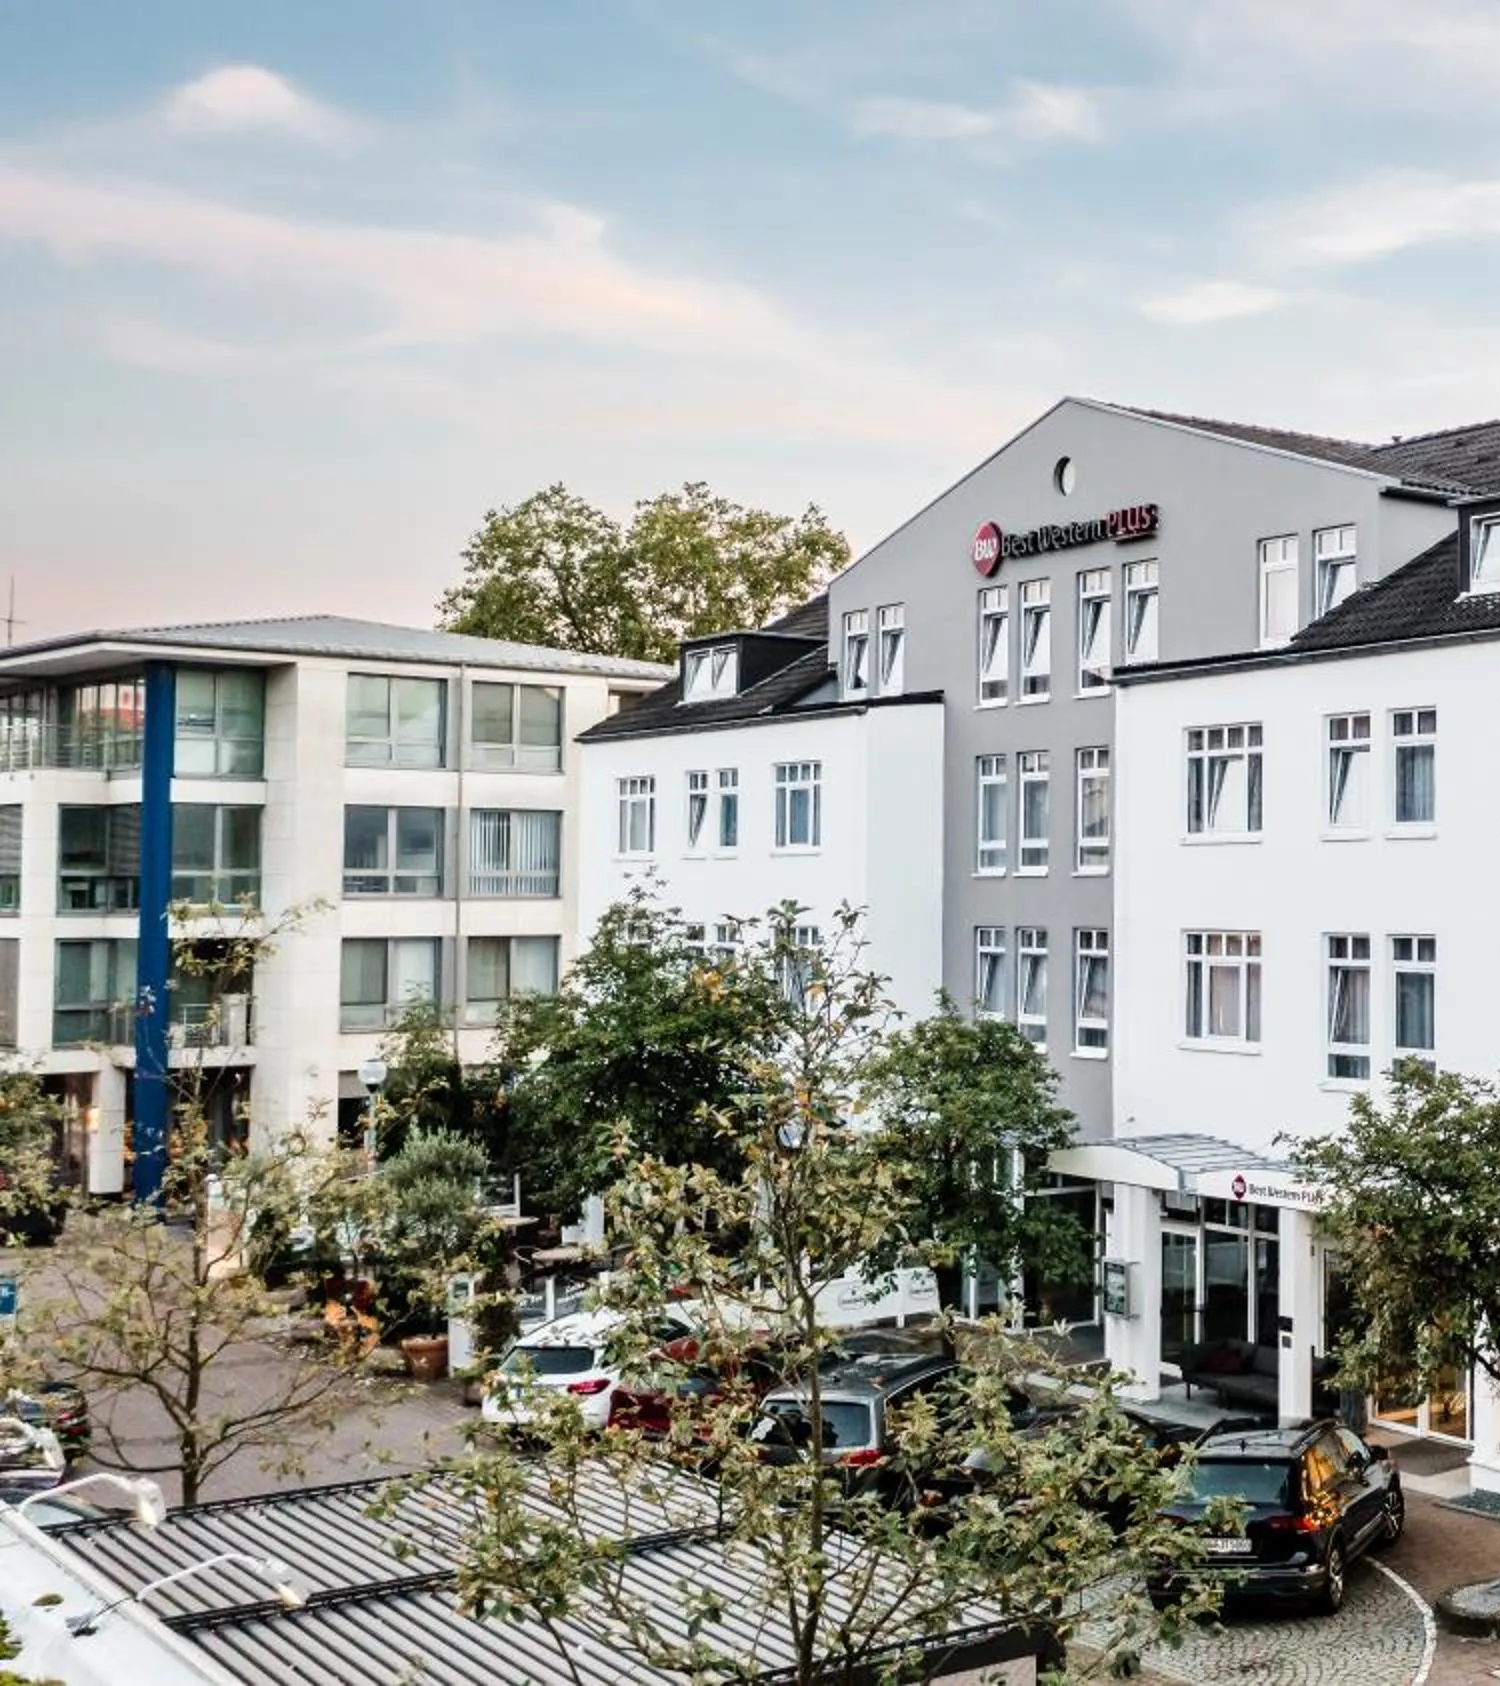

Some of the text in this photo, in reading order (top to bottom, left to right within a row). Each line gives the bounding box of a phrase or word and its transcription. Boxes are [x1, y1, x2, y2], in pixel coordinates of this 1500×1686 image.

[1002, 504, 1159, 559] Best Western PLUS
[975, 537, 998, 561] BW
[1249, 1183, 1266, 1197] Best
[1267, 1186, 1300, 1201] Western
